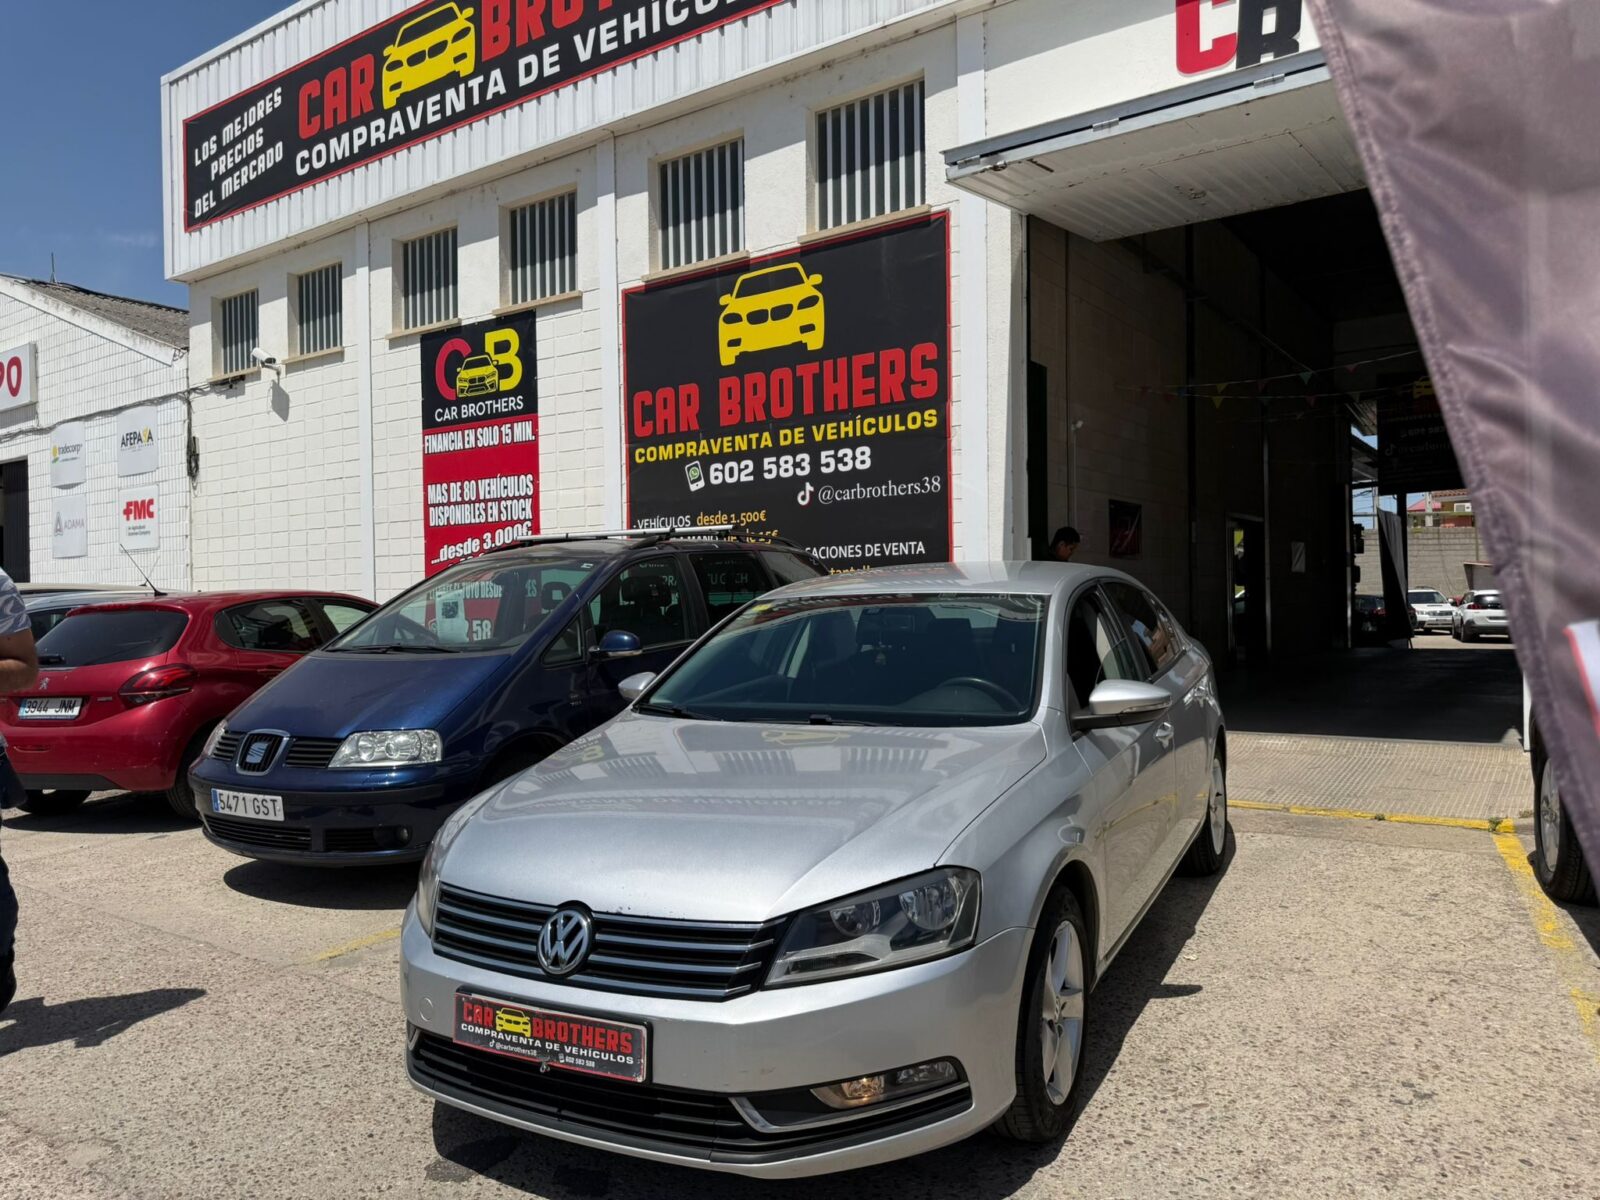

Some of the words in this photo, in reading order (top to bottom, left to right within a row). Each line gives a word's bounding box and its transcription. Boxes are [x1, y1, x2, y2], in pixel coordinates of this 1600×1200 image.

[299, 53, 375, 140] CAR
[482, 0, 612, 63] BR
[194, 135, 217, 167] LOS
[222, 86, 282, 147] MEJORES
[295, 68, 506, 176] COMPRAVENTA
[518, 43, 560, 87] DE
[211, 127, 264, 181] PRECIOS
[194, 190, 217, 218] DEL
[221, 141, 283, 200] MERCADO
[633, 383, 700, 438] CAR
[719, 342, 938, 427] BROTHERS
[434, 406, 458, 422] CAR
[461, 395, 524, 418] BROTHERS
[424, 430, 463, 454] FINANCIA
[464, 429, 475, 449] EN
[476, 425, 499, 447] SOLO
[501, 423, 512, 444] 15
[513, 420, 535, 443] MIN.
[634, 431, 773, 464] COMPRAVENTA
[780, 427, 805, 447] DE
[812, 409, 938, 442] VEHÍCULOS
[709, 460, 754, 485] 602
[763, 453, 810, 479] 583
[820, 446, 872, 473] 538
[427, 483, 448, 505] MAS
[449, 482, 461, 502] DE
[463, 480, 476, 501] 80
[478, 473, 534, 500] VEHÍCULOS
[818, 475, 941, 504] @carbrothers38
[123, 498, 155, 521] FMC
[429, 502, 486, 527] DISPONIBLES
[487, 501, 498, 522] EN
[500, 498, 532, 521] STOCK
[637, 515, 691, 529] VEHÍCULOS
[696, 510, 728, 526] desde
[730, 510, 767, 526] 1.500€
[483, 521, 532, 550] 3.000€
[865, 543, 882, 557] DE
[883, 541, 925, 556] VENTA
[25, 700, 48, 713] 3944
[219, 793, 247, 814] 5471
[252, 797, 278, 817] GST
[461, 1023, 542, 1049] COMPRAVENTA
[546, 1041, 560, 1052] DE
[564, 1045, 634, 1064] VEHÍCULOS
[463, 1002, 494, 1027] CAR
[532, 1017, 633, 1054] BROTHERS
